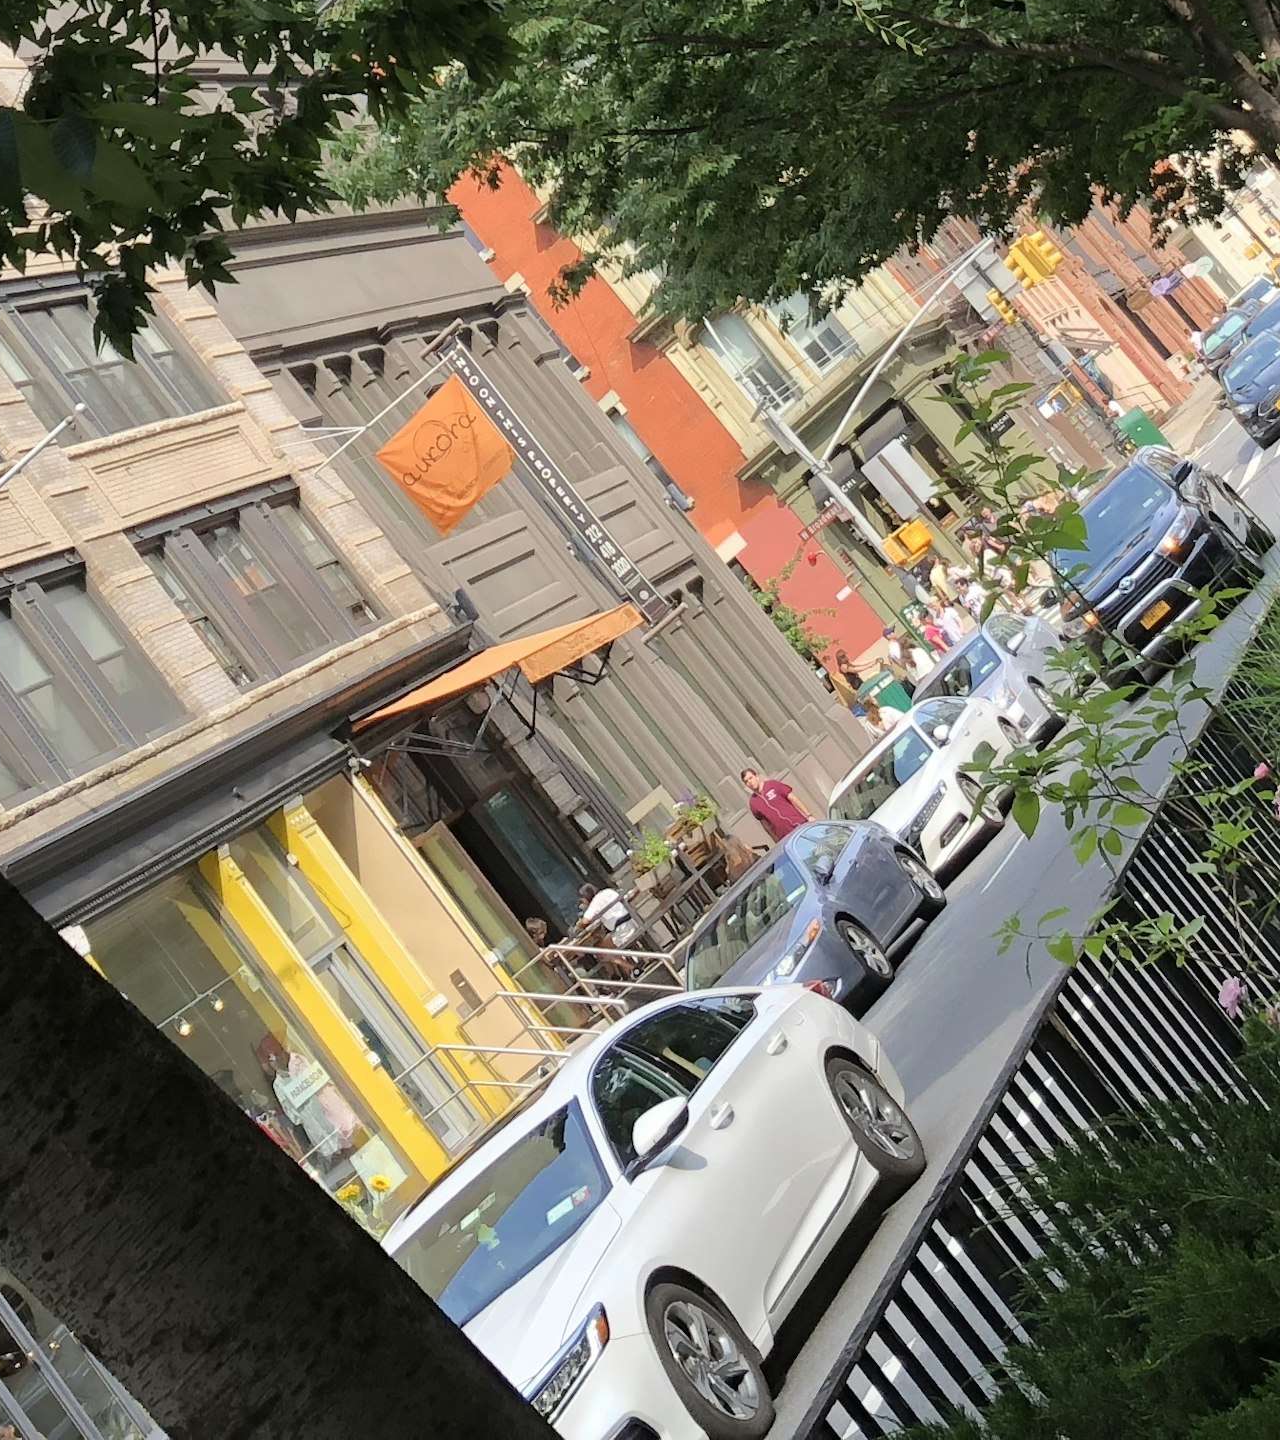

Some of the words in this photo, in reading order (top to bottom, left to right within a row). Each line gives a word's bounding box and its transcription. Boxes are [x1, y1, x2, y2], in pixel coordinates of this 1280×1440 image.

[402, 413, 477, 486] aurora
[478, 387, 496, 408] ON
[495, 409, 527, 448] THIS
[526, 450, 586, 524] PROPERTY
[800, 527, 810, 541] W
[808, 505, 839, 533] Broadway
